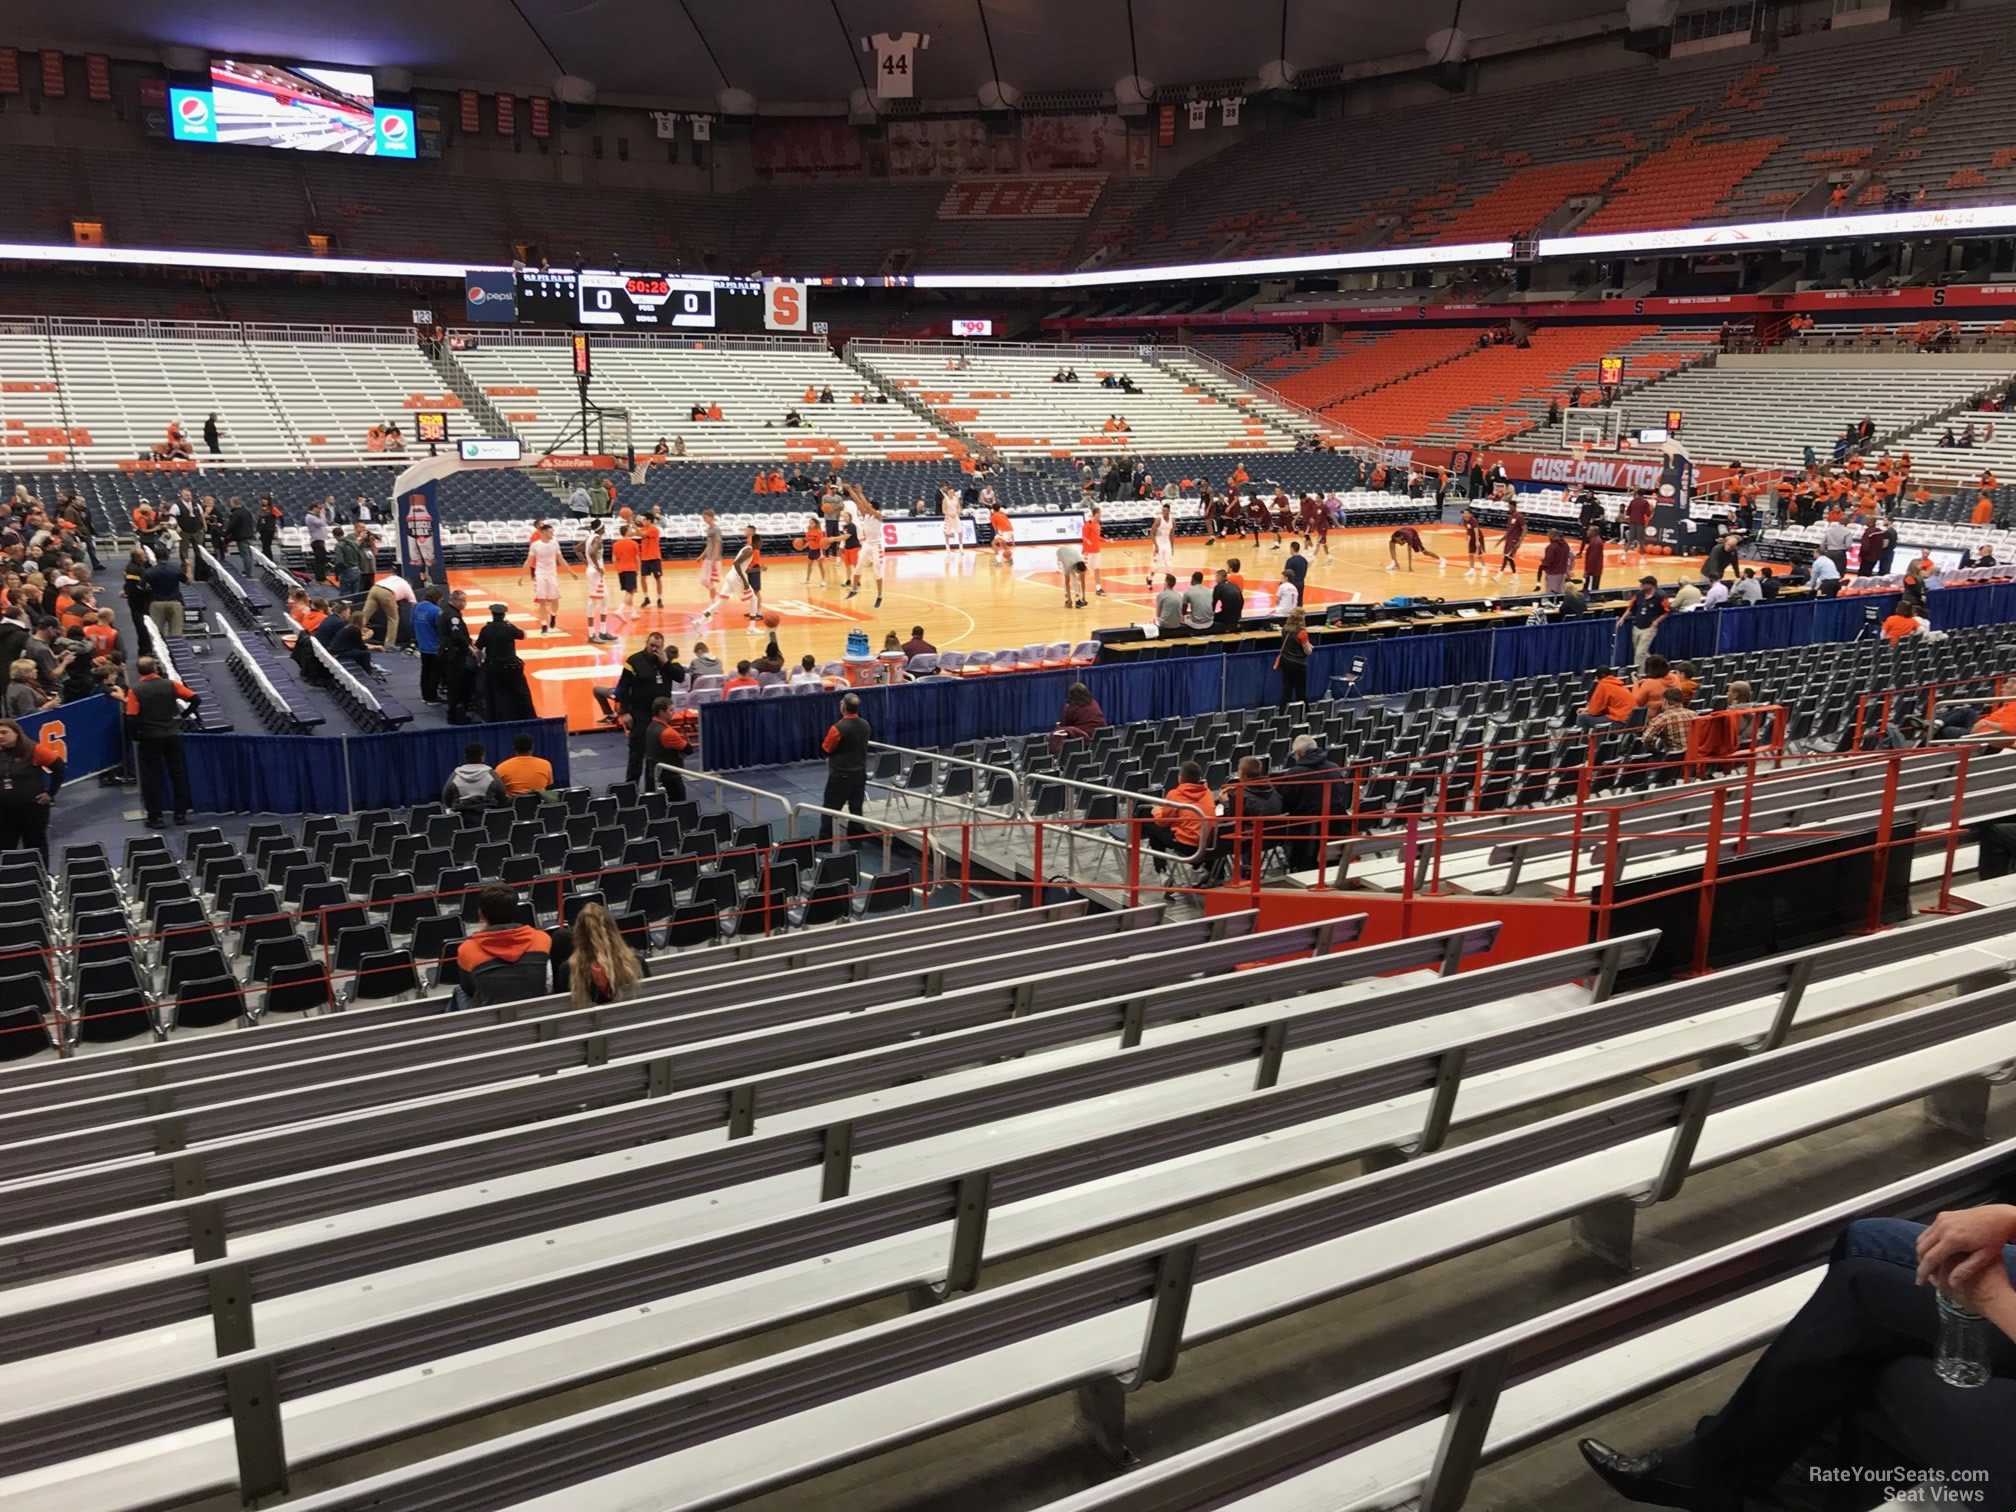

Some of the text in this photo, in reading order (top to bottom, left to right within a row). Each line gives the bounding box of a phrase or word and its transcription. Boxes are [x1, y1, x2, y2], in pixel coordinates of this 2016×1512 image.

[883, 55, 907, 74] 44
[627, 280, 670, 293] 50:28
[487, 292, 512, 302] pepsi
[597, 290, 612, 309] 0
[684, 294, 698, 312] 0
[1933, 290, 1946, 305] S
[773, 287, 799, 325] S
[1419, 306, 1426, 319] S
[1635, 300, 1643, 314] S
[415, 311, 431, 323] 123
[966, 321, 985, 332] 99
[1603, 369, 1619, 383] 30
[423, 426, 439, 439] 30
[1453, 453, 1468, 474] S
[883, 524, 898, 545] S
